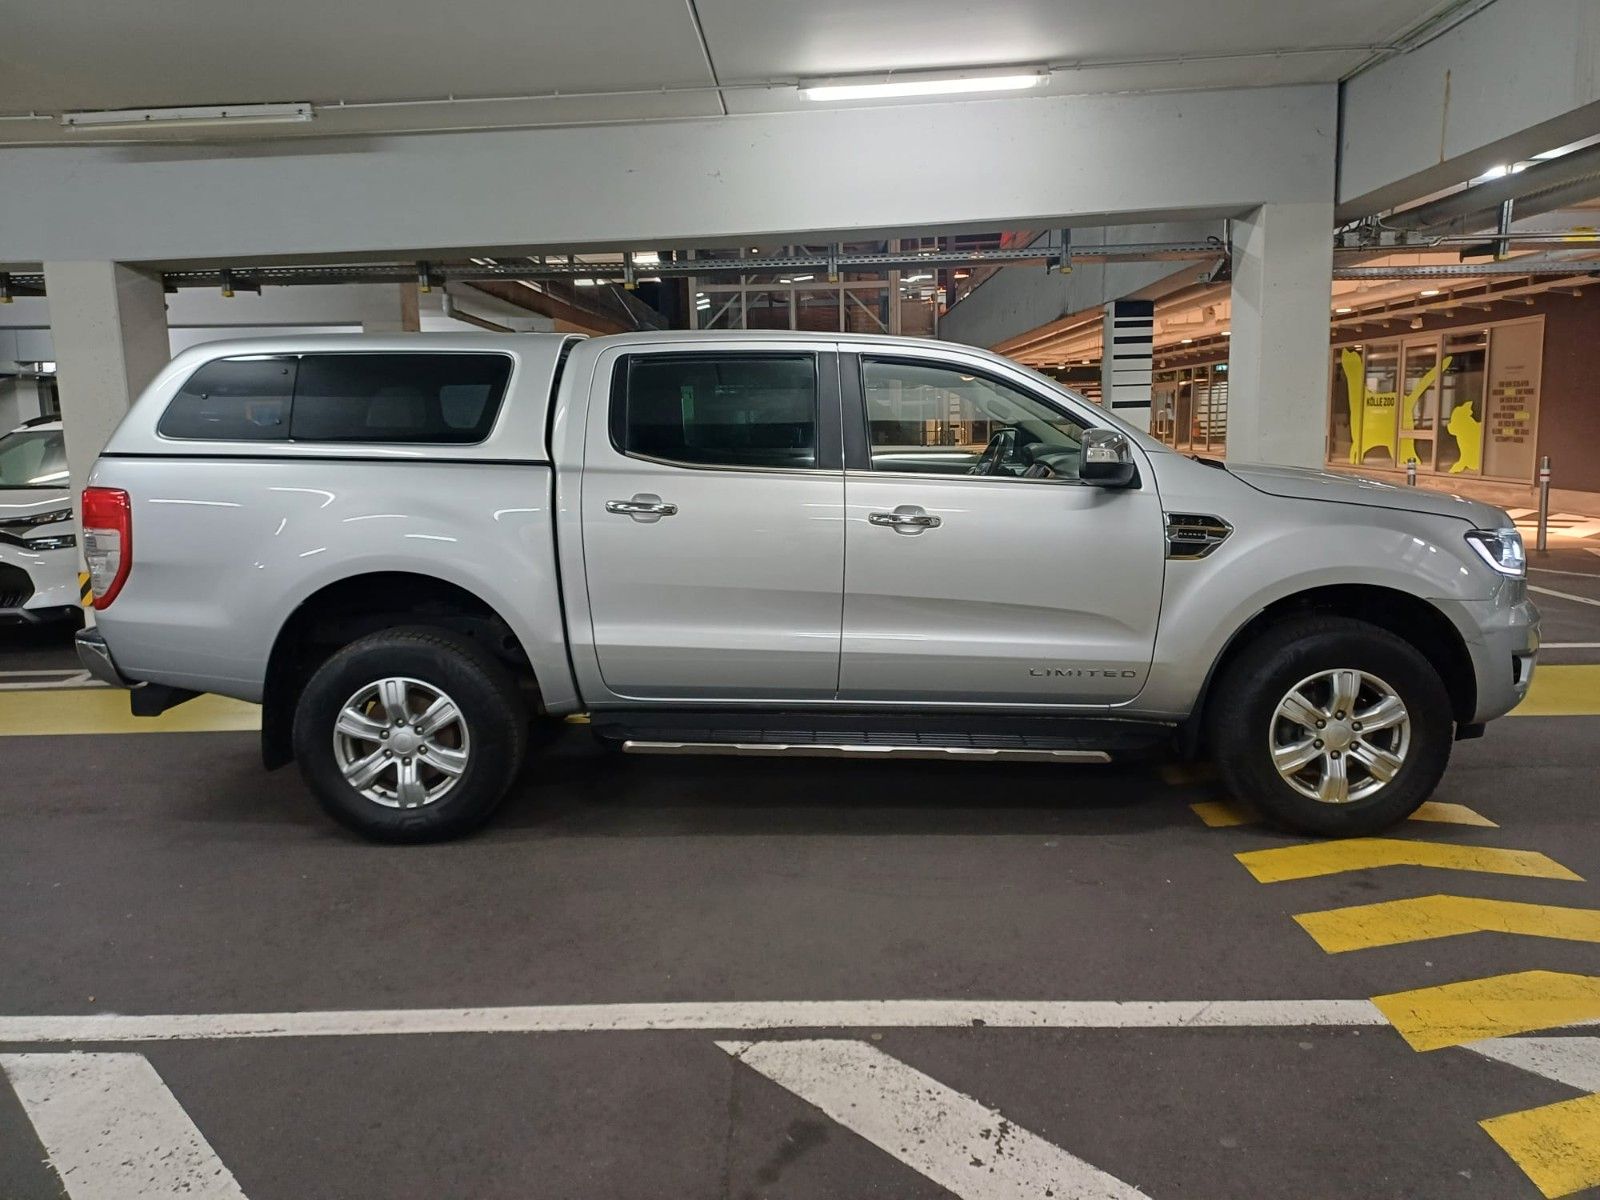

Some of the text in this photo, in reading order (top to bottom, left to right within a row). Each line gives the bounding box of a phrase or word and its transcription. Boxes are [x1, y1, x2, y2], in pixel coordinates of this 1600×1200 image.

[1366, 396, 1395, 407] KÖLLE ZOO
[1029, 668, 1136, 678] LIMITED
